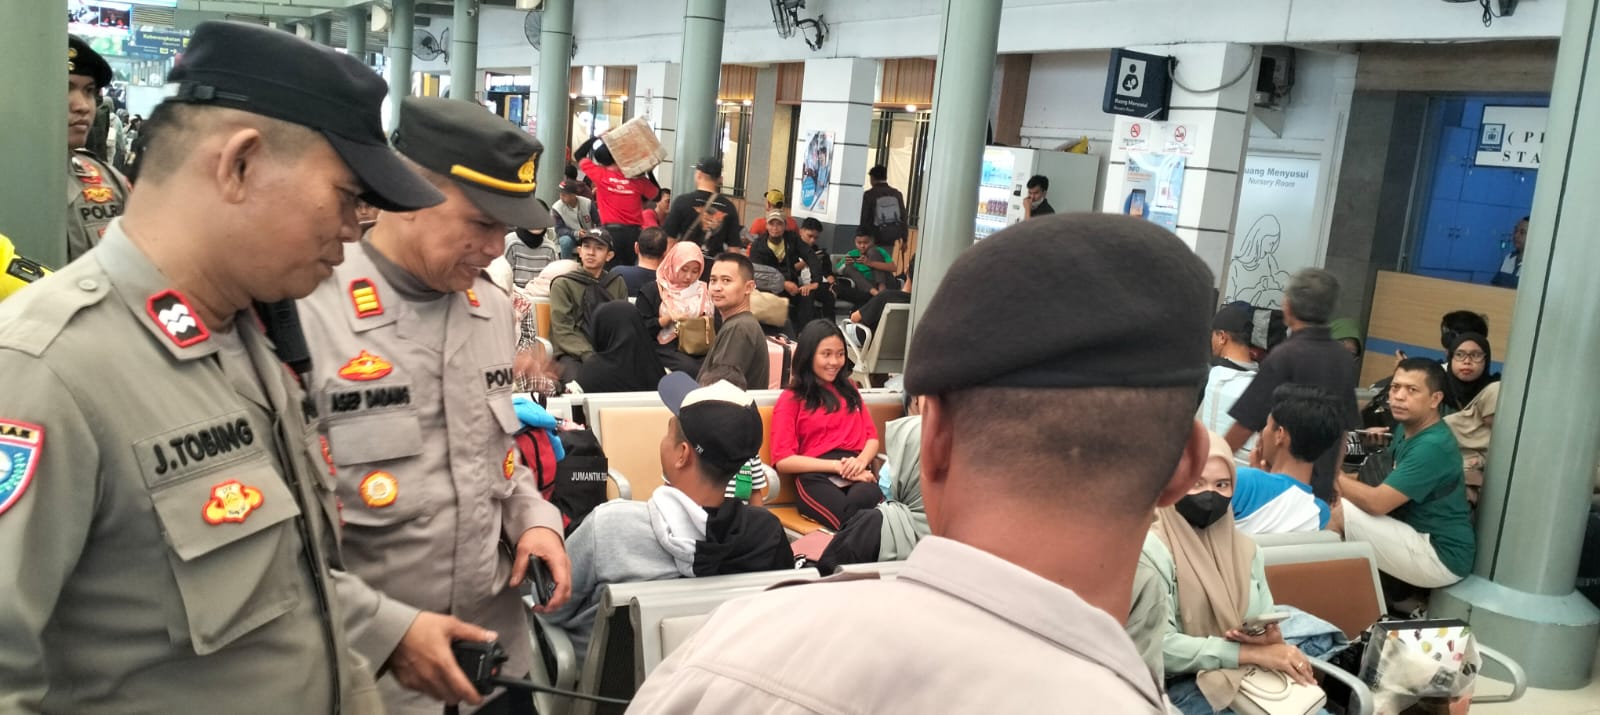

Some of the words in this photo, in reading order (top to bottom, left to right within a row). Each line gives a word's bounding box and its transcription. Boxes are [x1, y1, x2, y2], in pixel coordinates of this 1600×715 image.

[1244, 167, 1265, 177] uang
[1267, 167, 1309, 179] Menyusui
[1248, 177, 1274, 187] Nursery
[1275, 179, 1296, 188] Room
[80, 204, 121, 221] POLR
